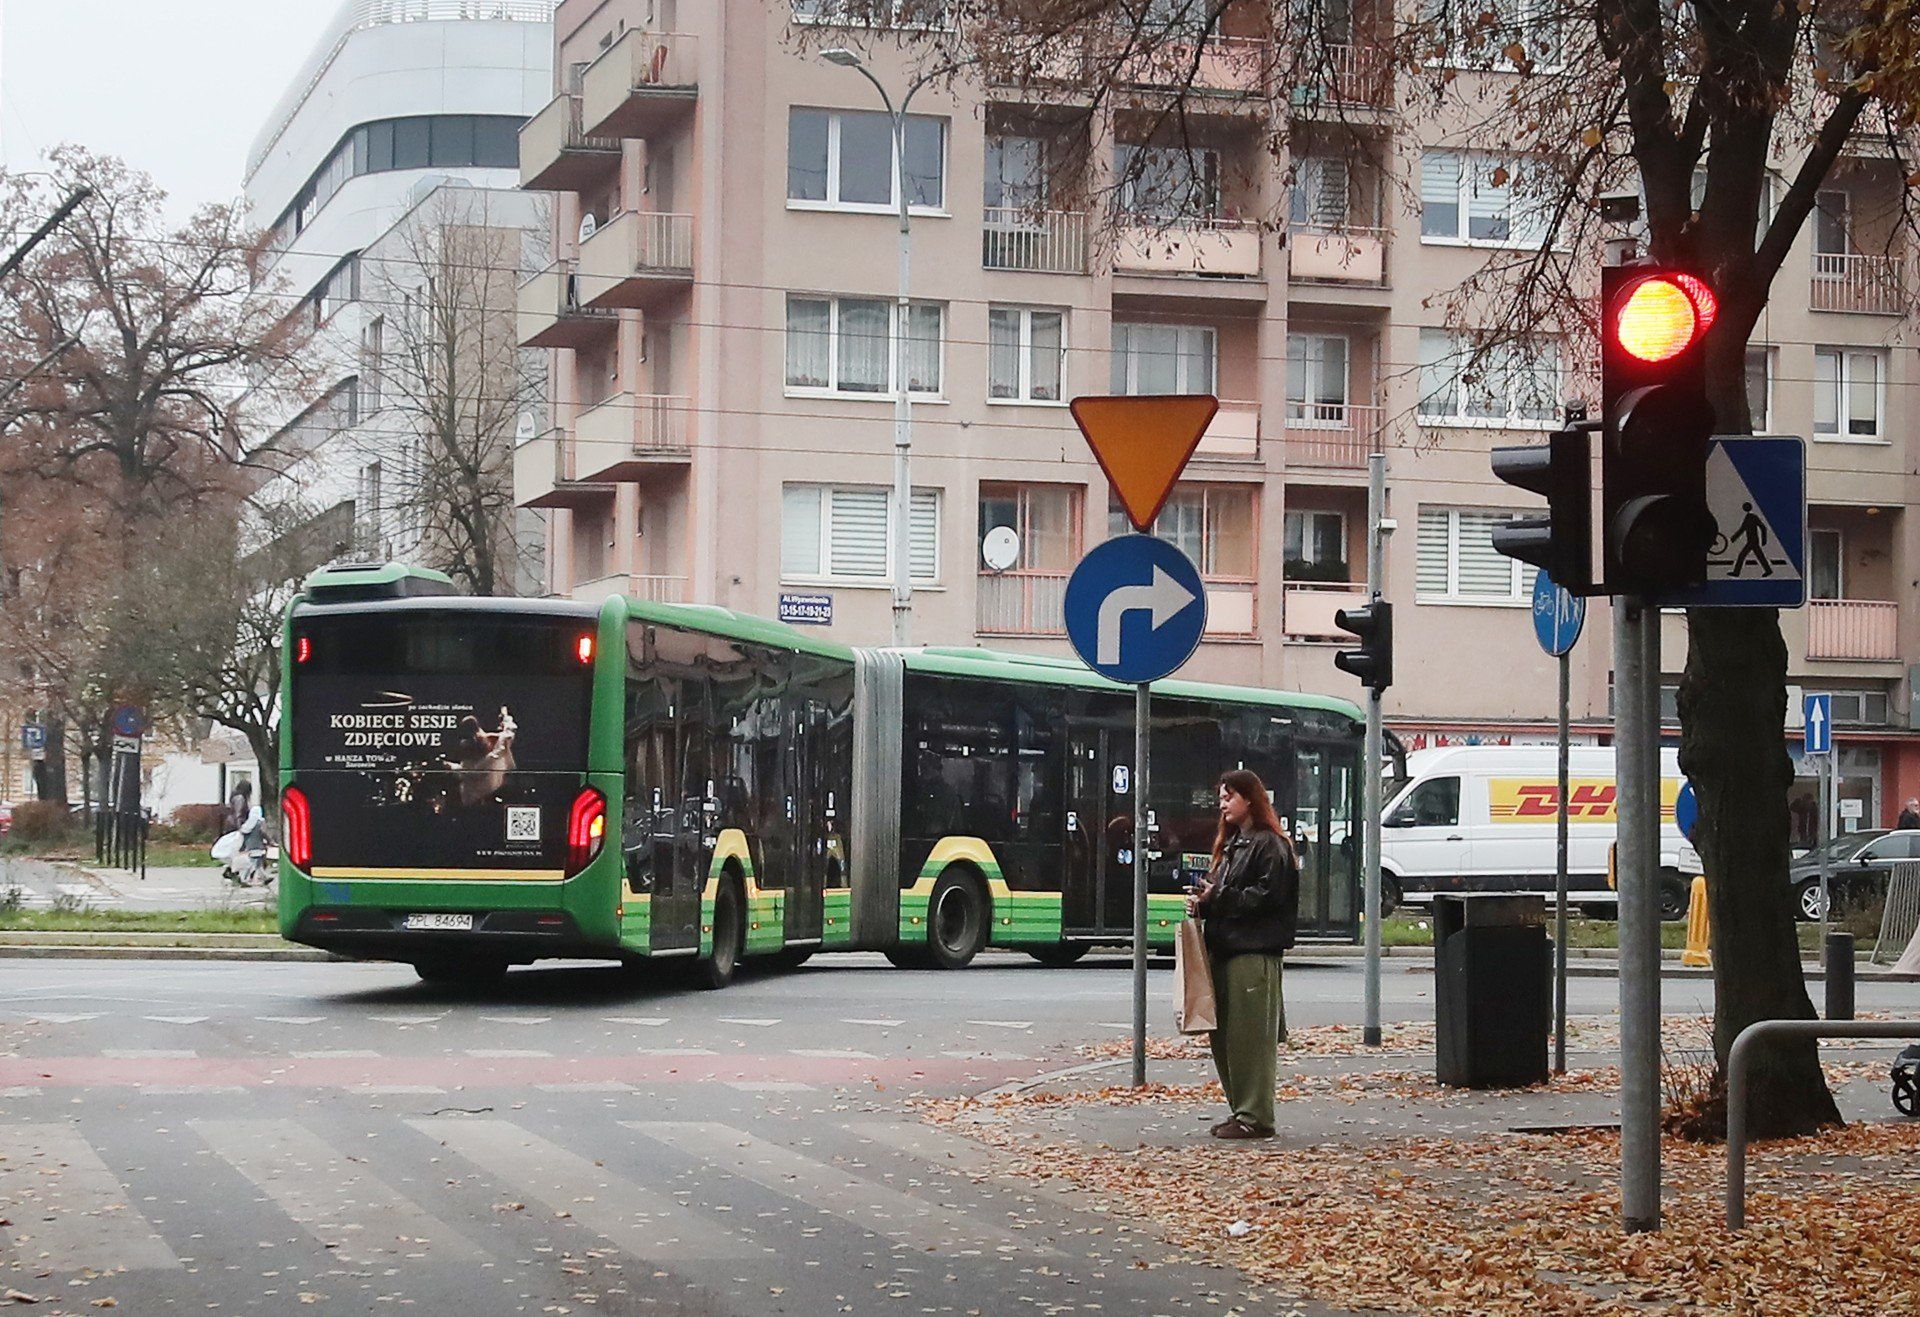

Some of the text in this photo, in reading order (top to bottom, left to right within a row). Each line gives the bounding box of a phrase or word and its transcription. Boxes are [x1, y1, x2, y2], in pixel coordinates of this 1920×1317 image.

[330, 714, 458, 729] KOBIECE SESJE
[344, 732, 442, 750] ZDJĘCIOWE
[1515, 785, 1617, 816] DH
[409, 914, 470, 927] ZPL 84694
